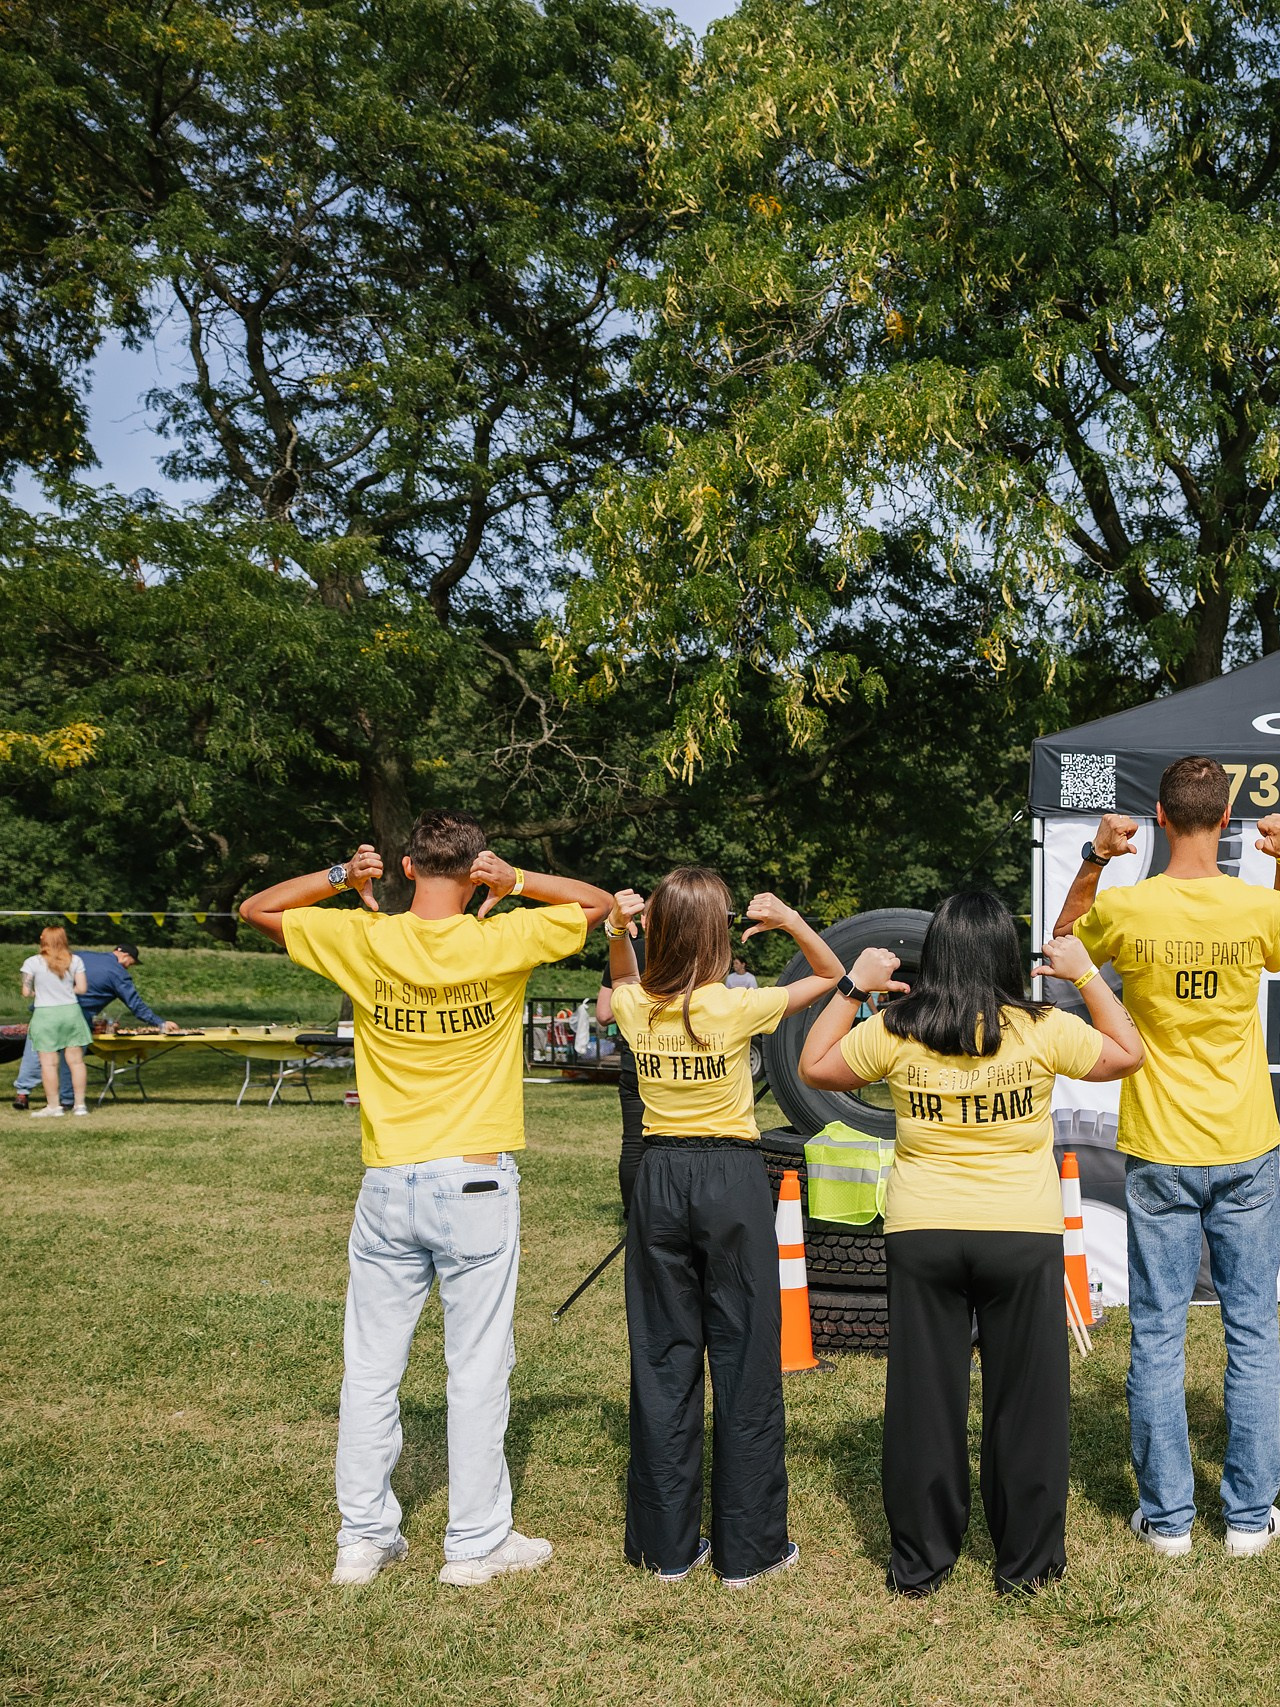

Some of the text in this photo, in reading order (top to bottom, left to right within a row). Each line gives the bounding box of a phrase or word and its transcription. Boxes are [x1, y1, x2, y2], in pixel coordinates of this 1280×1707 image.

[1135, 938, 1255, 965] PIT STOP PARTY
[375, 979, 488, 1005] PIT STOP PARTY
[1175, 970, 1218, 999] CEO
[373, 1001, 496, 1034] FLEET TEAM
[636, 1033, 652, 1051] PIT
[657, 1034, 686, 1052] STOP
[636, 1052, 727, 1080] HR TEAM
[907, 1064, 929, 1089] PIT
[987, 1059, 1033, 1088] PARTY
[908, 1086, 1033, 1124] HR TEAM
